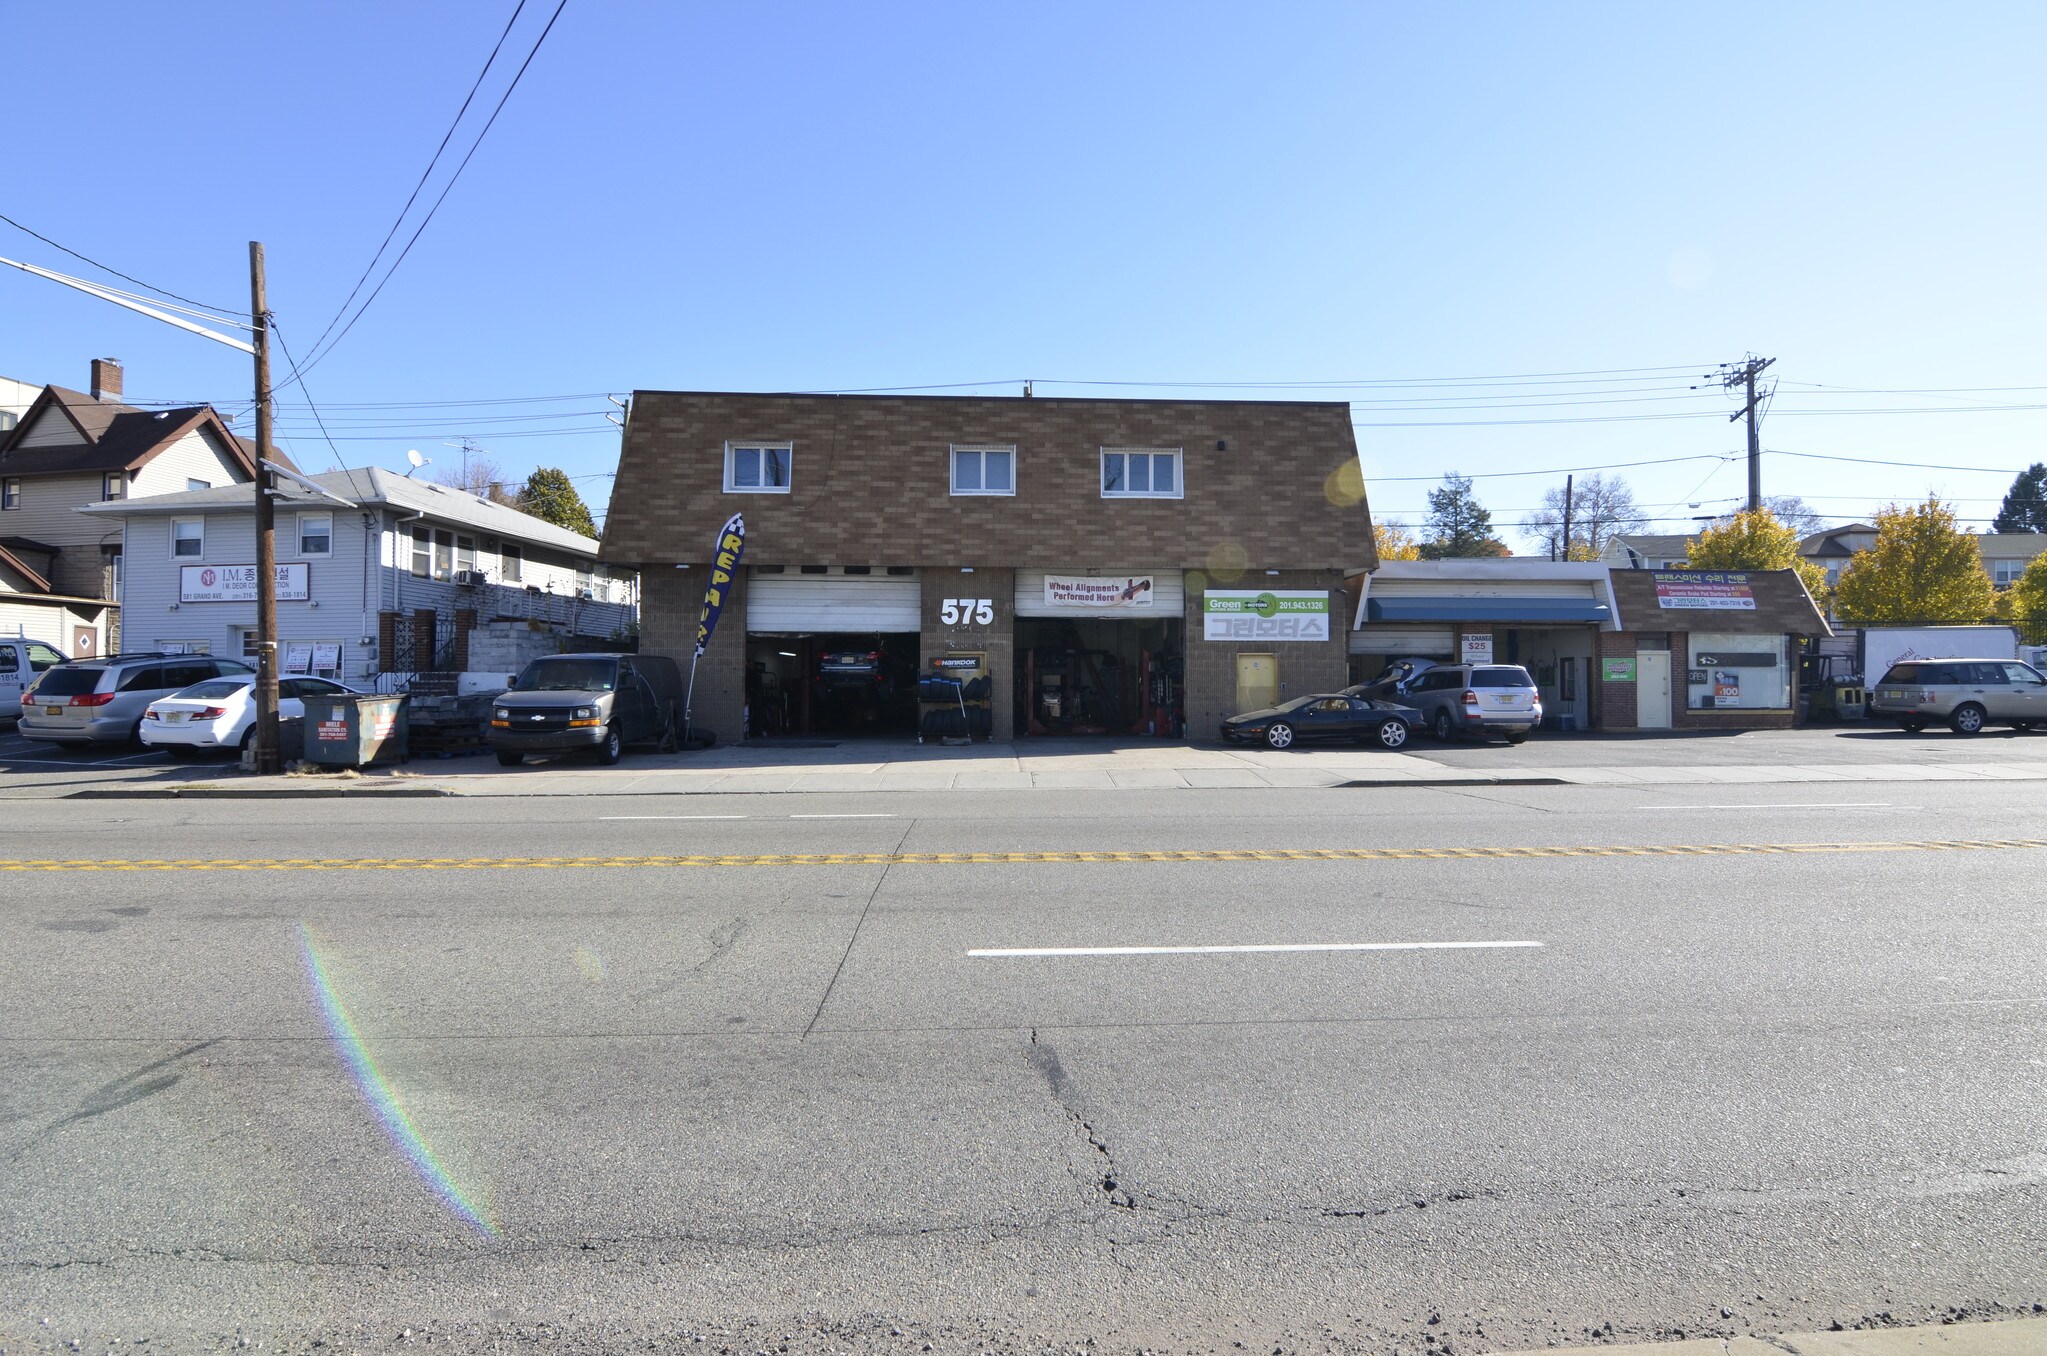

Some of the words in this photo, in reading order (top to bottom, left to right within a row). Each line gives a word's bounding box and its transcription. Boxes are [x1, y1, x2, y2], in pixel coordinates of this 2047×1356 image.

[244, 567, 289, 582] 종설
[1655, 574, 1702, 583] 트랜스미션
[1705, 574, 1724, 583] 수리
[1727, 574, 1748, 584] 전문
[697, 533, 742, 642] REPAIR
[1049, 582, 1073, 592] Wheel
[1075, 583, 1120, 593] Alignments
[193, 592, 212, 600] GRAND
[1053, 592, 1095, 601] Performed
[1097, 593, 1115, 602] Here
[1210, 599, 1241, 609] Green
[1279, 601, 1323, 610] 201.943.1326
[941, 599, 994, 625] 575
[1210, 618, 1324, 638] 그린모터스
[1468, 642, 1486, 650] $25
[1886, 647, 1915, 669] General
[1689, 672, 1706, 681] OPEN
